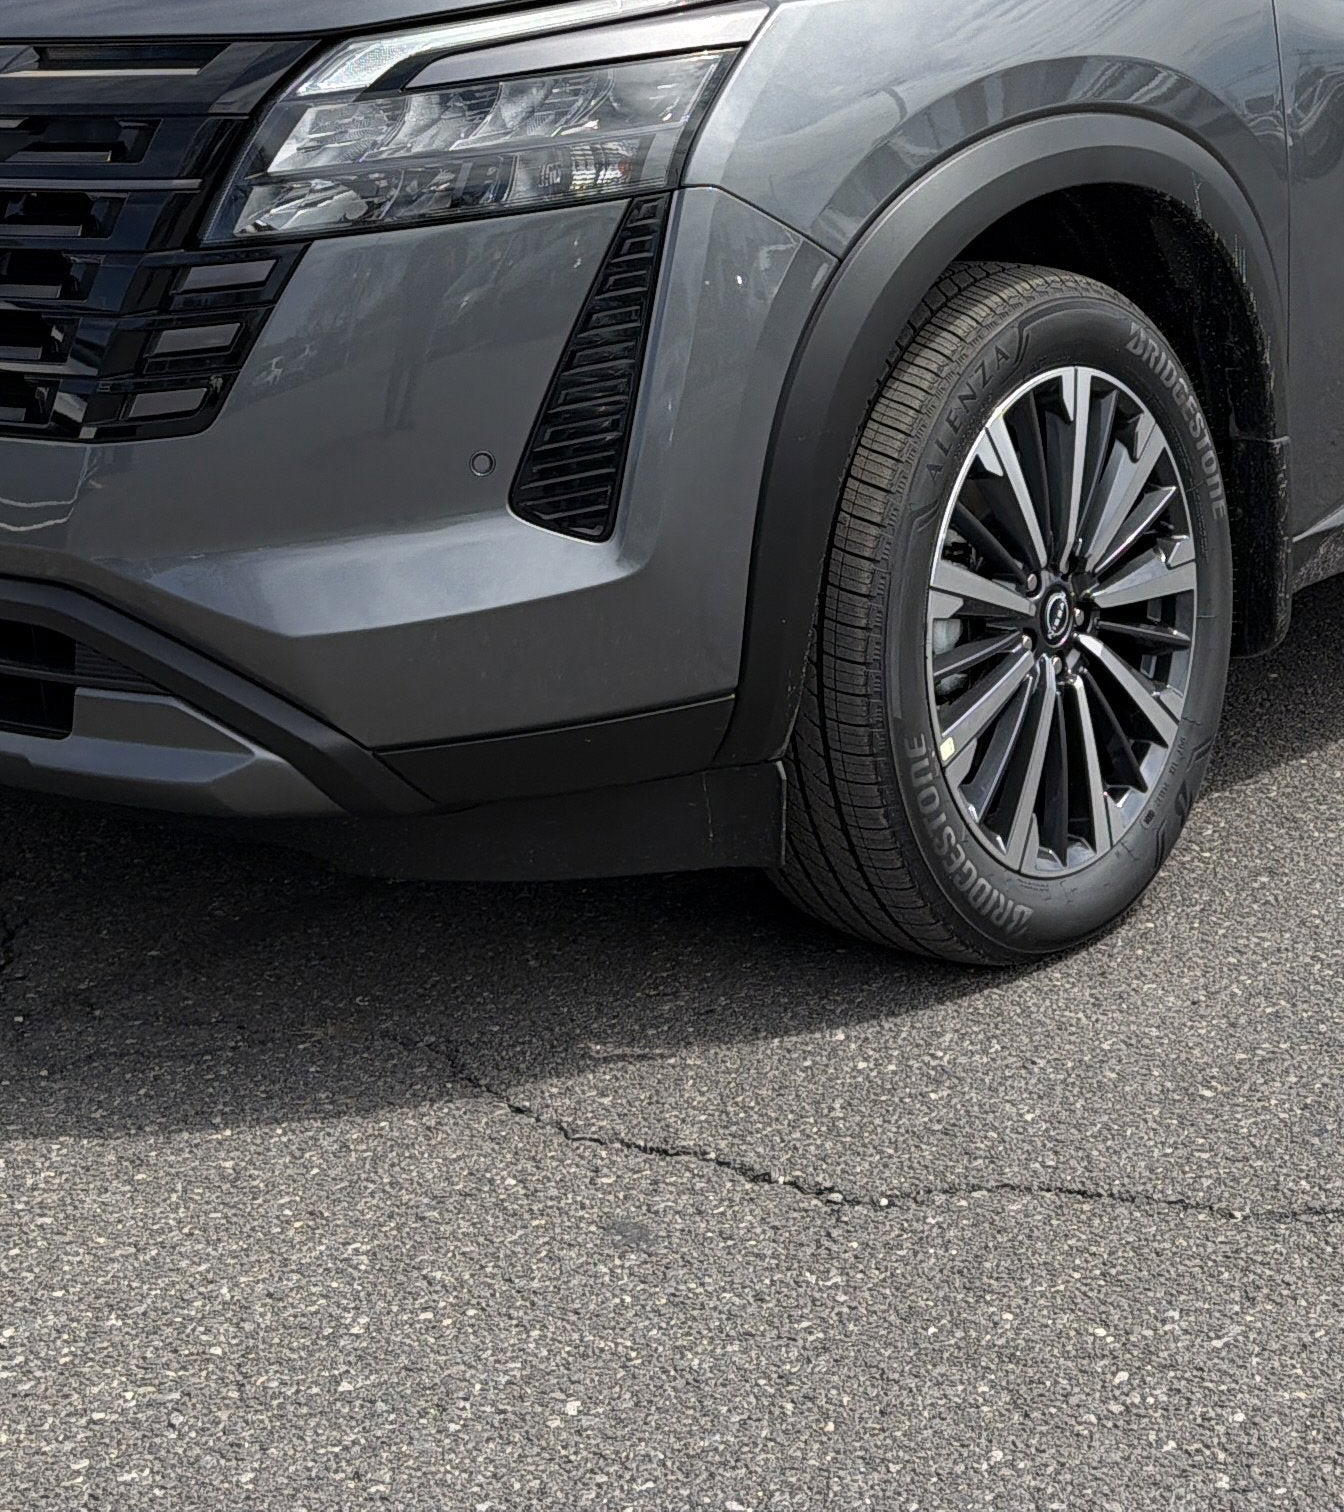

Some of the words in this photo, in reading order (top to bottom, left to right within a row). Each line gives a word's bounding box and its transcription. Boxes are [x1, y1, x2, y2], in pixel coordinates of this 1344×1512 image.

[926, 344, 1011, 481] ALENZA
[1125, 321, 1226, 520] BRIDGESTONE
[908, 733, 1034, 935] BRIDGESTONE
